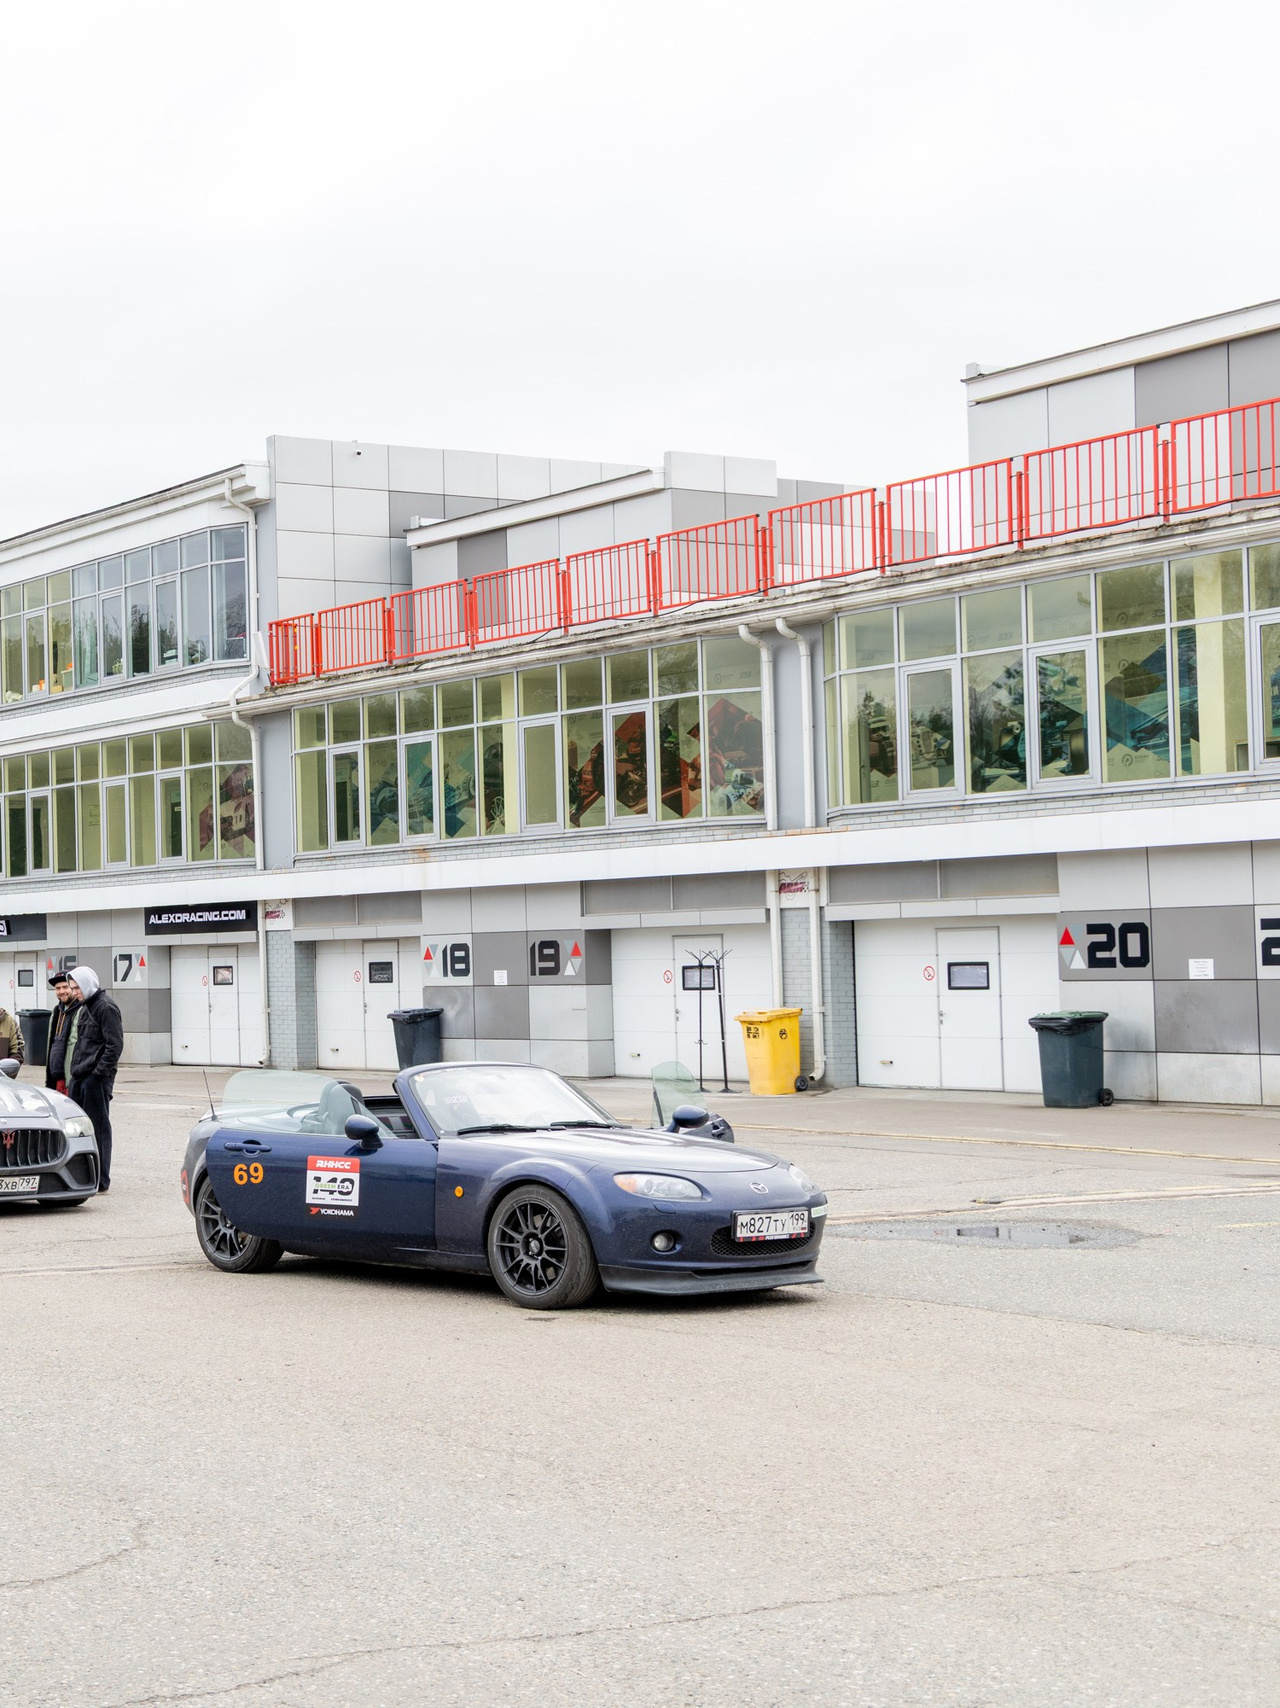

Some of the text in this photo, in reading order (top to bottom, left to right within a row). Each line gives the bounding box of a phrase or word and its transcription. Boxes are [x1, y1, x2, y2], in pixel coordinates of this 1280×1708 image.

[149, 910, 246, 924] ALEXDRACING.COM
[1086, 922, 1150, 968] 20
[442, 943, 470, 977] 18
[529, 940, 561, 976] 19
[114, 954, 132, 982] 17
[233, 1162, 264, 1185] 69
[316, 1160, 351, 1169] RHHCC
[20, 1178, 36, 1186] 797
[320, 1208, 354, 1217] YOKOHAMA
[789, 1213, 806, 1226] 199
